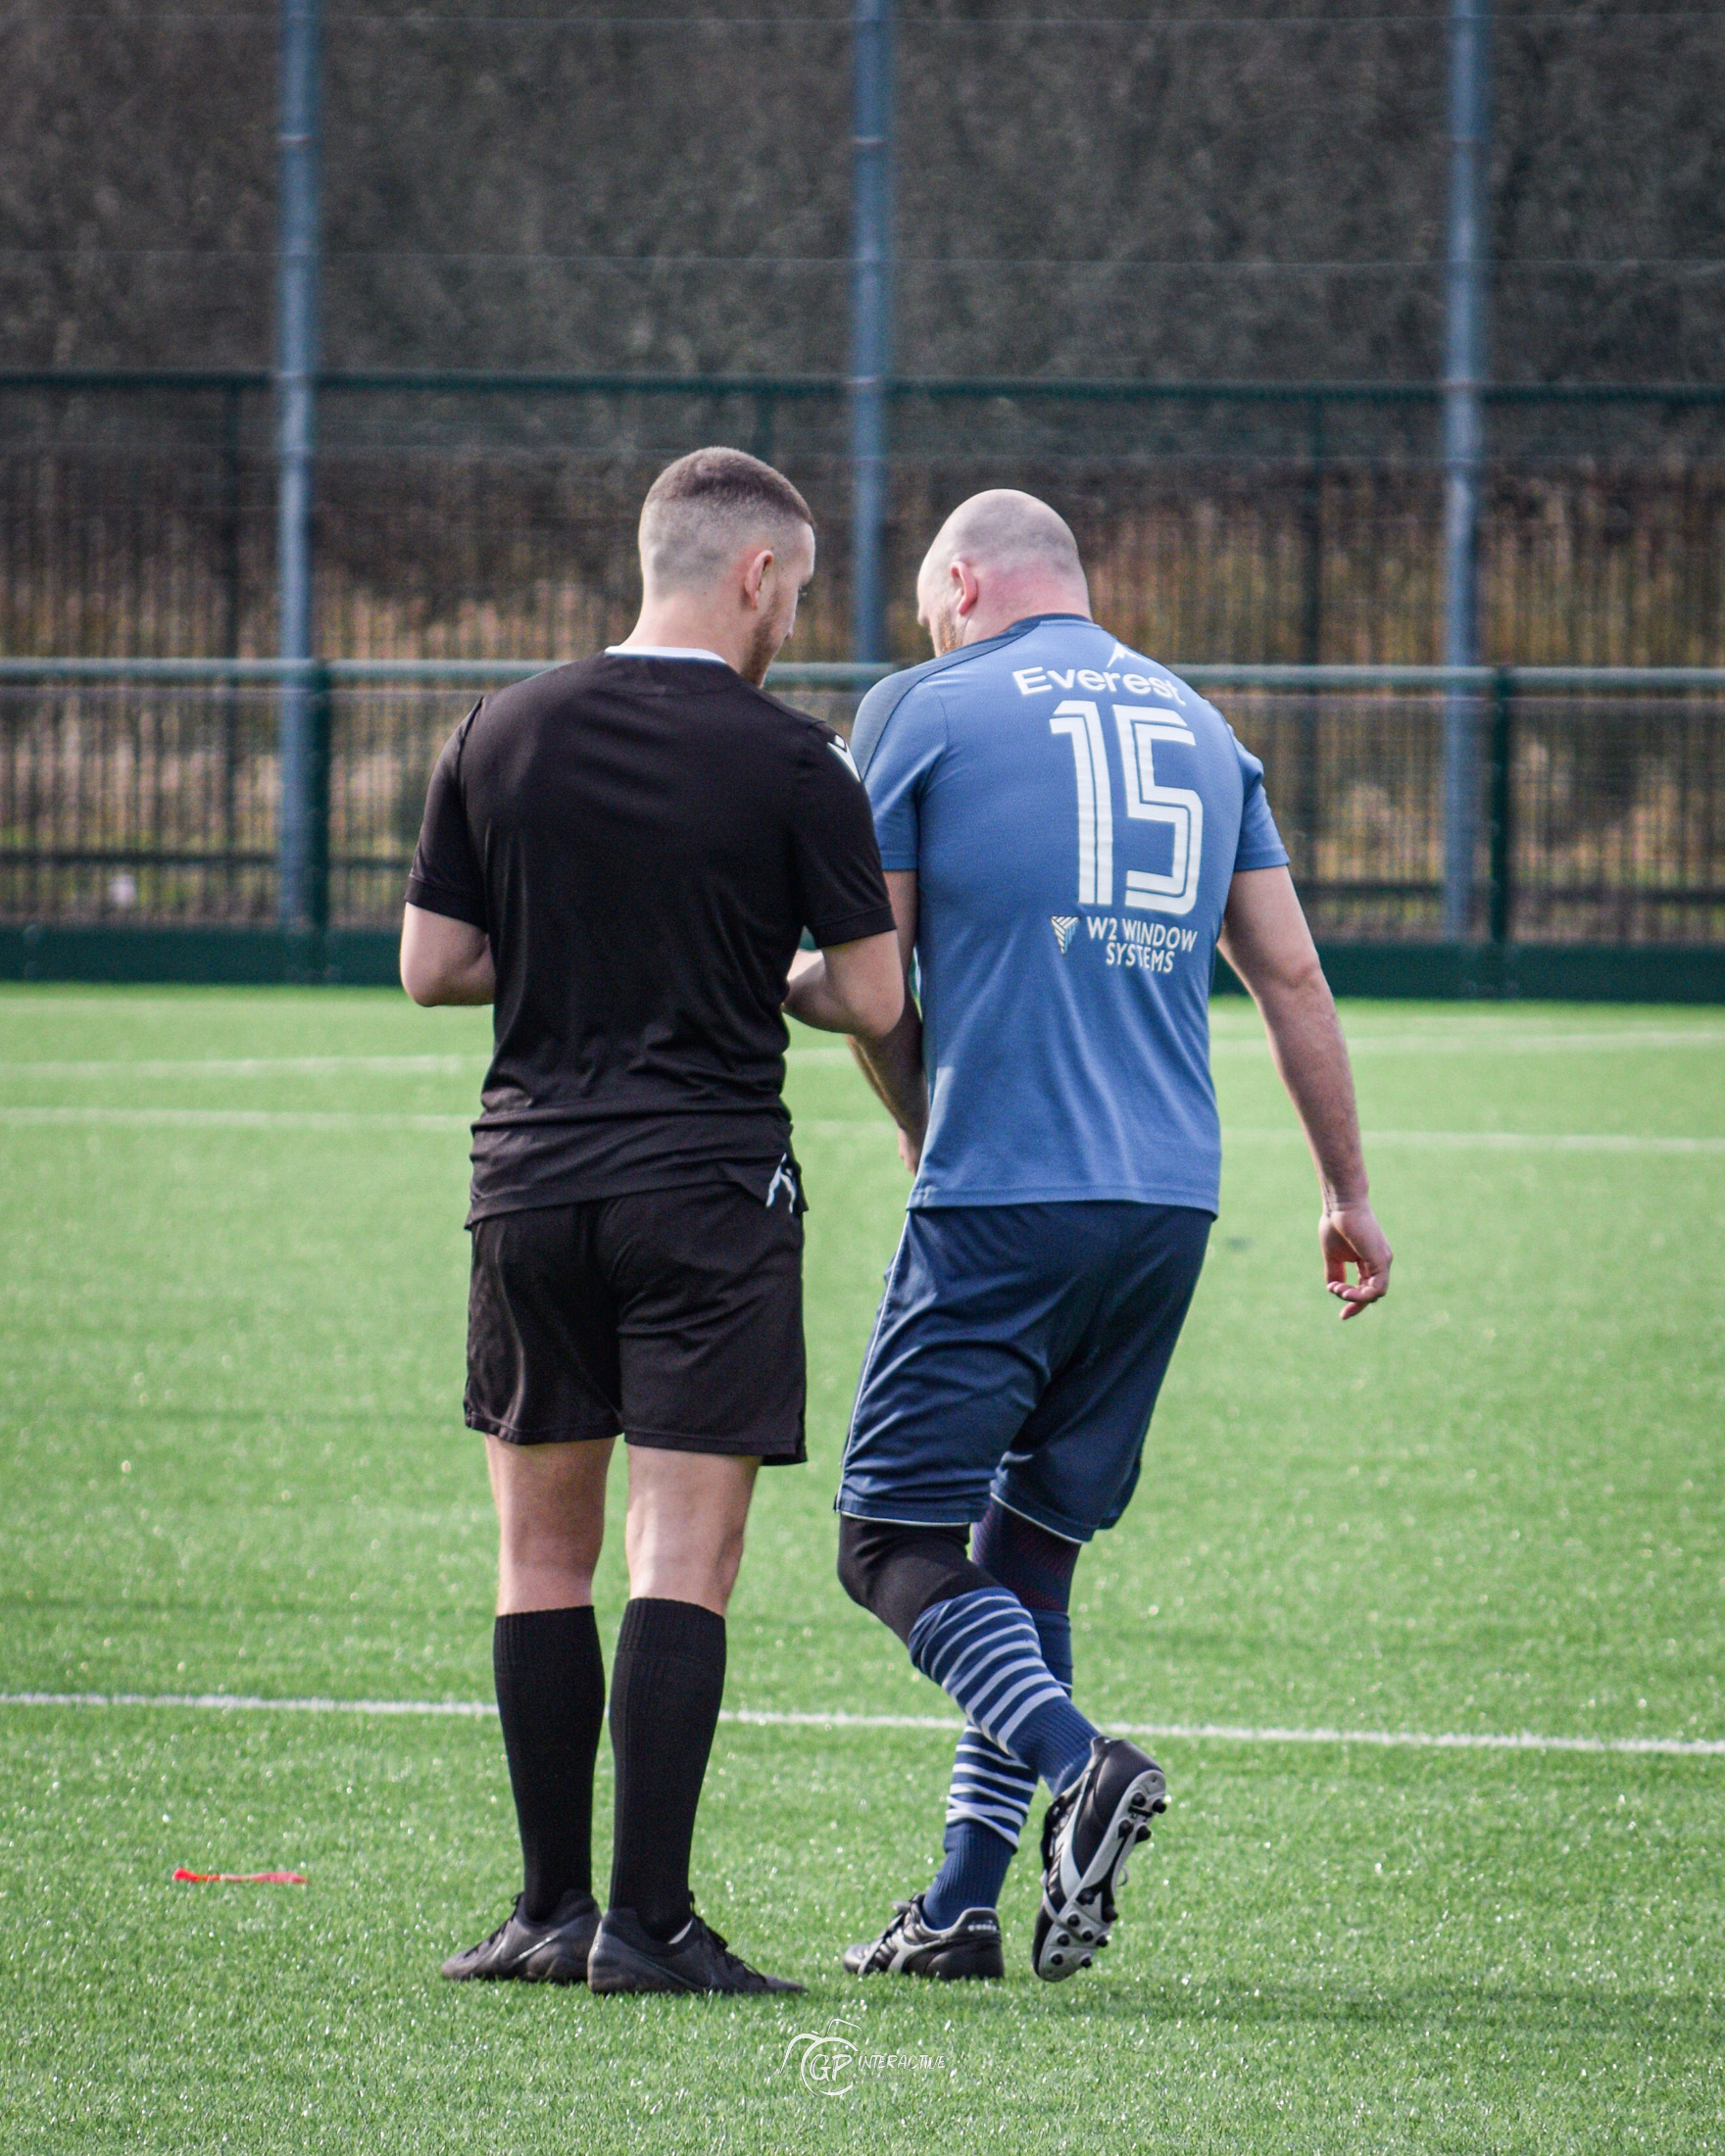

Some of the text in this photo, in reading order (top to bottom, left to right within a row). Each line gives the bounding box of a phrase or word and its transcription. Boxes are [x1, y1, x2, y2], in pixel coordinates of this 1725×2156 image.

[1012, 666, 1187, 706] Everest
[1049, 700, 1204, 915] 15
[1087, 916, 1198, 953] W2 WINDOW
[1106, 942, 1175, 974] SYSTEMS
